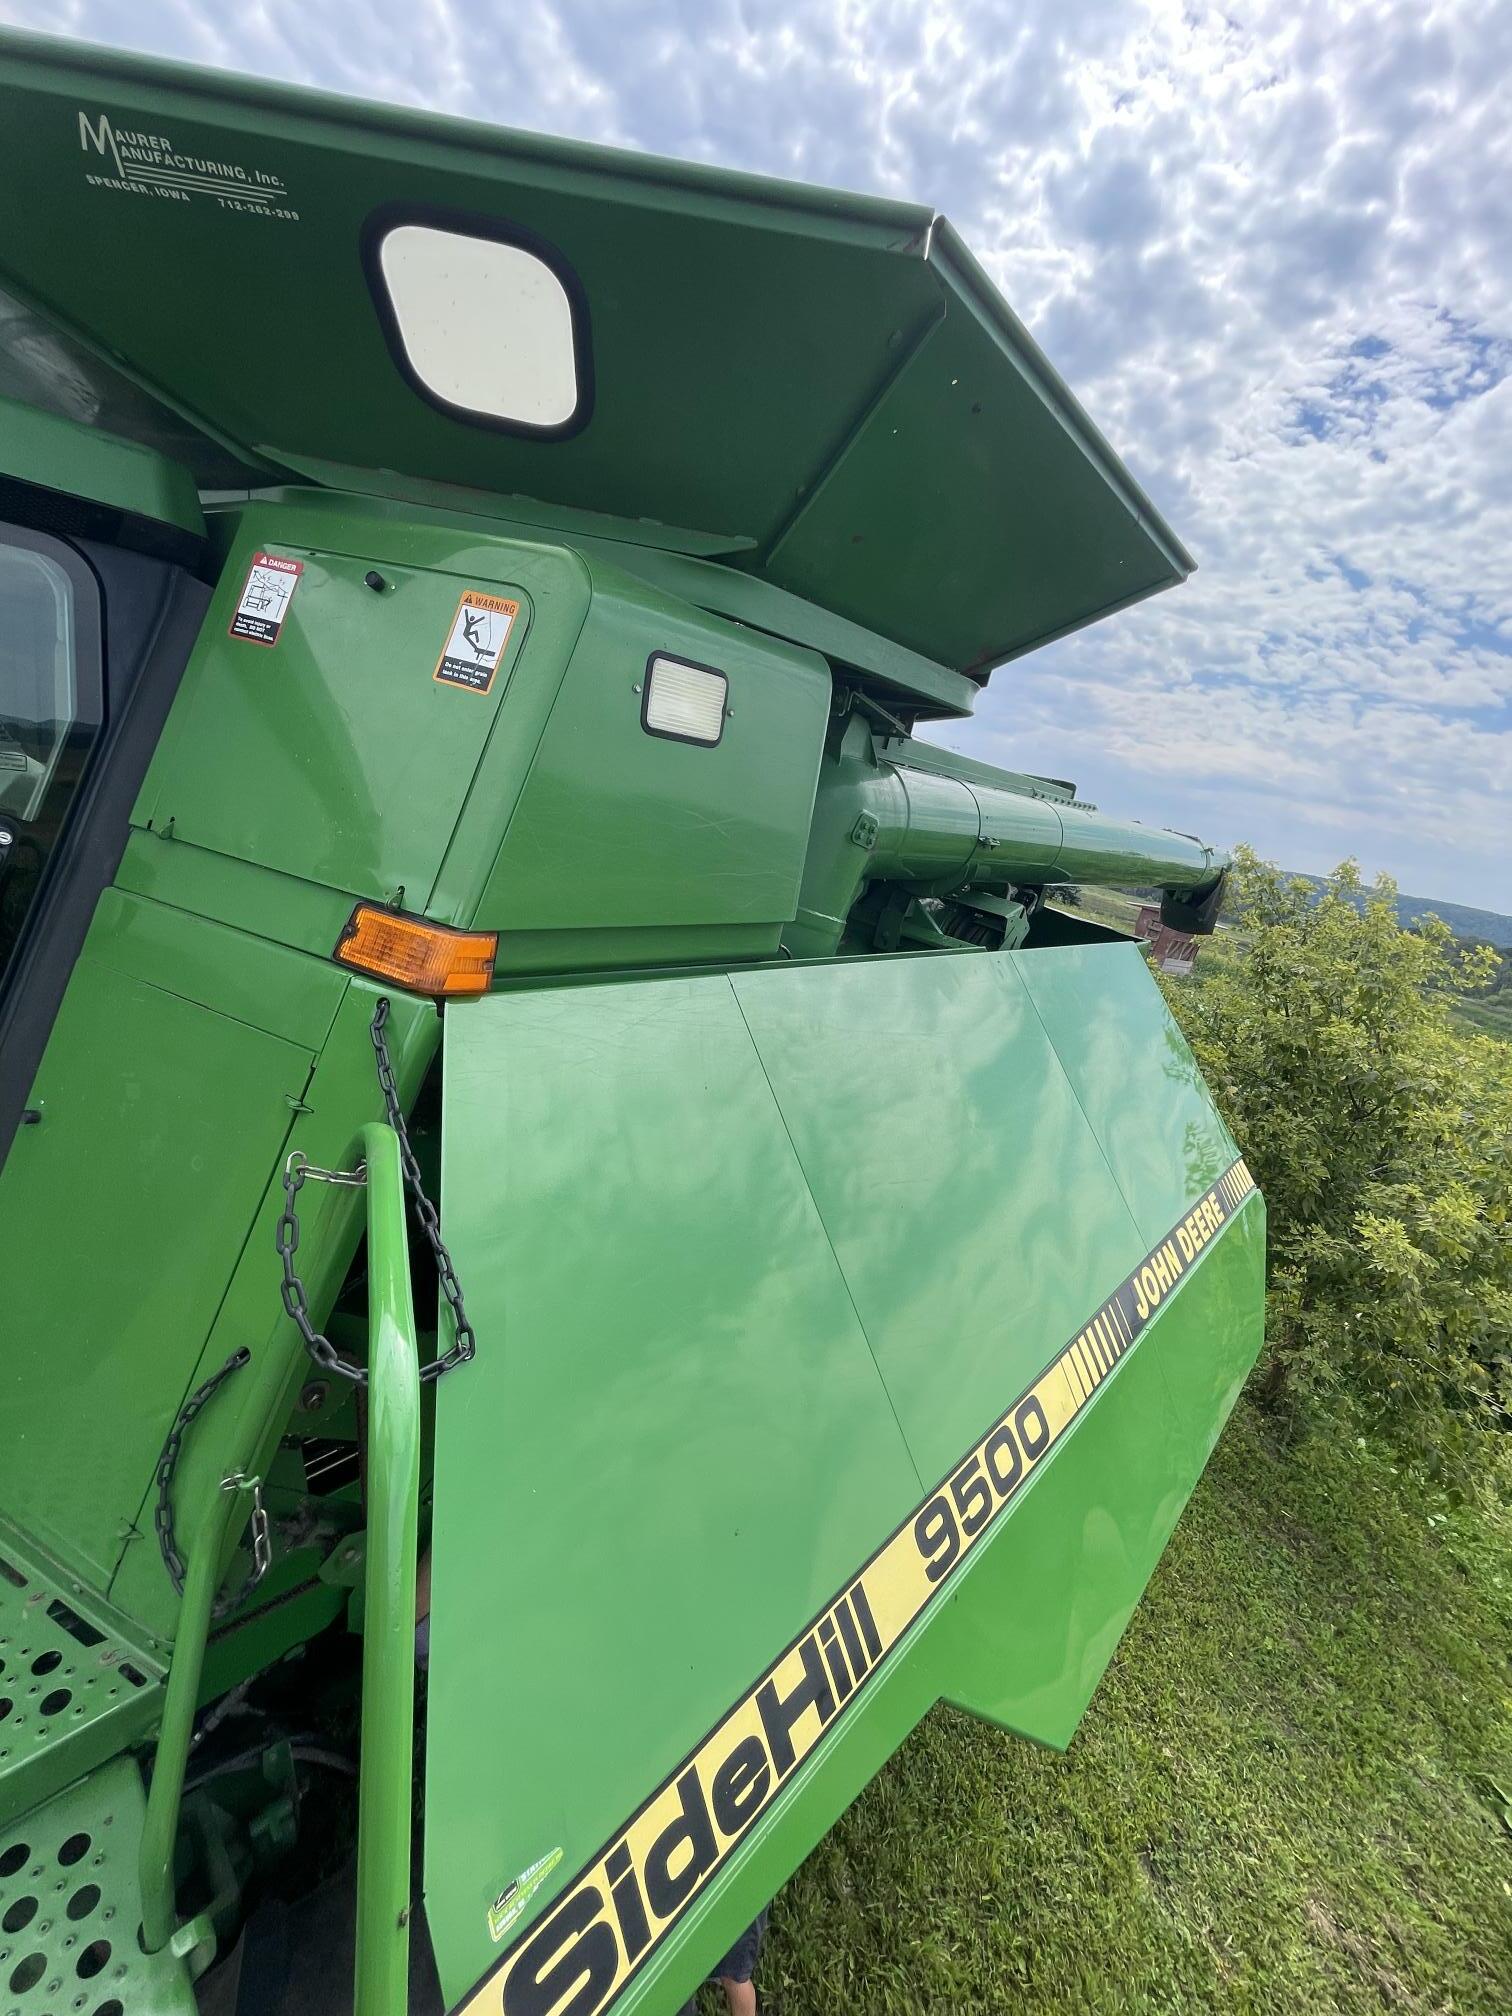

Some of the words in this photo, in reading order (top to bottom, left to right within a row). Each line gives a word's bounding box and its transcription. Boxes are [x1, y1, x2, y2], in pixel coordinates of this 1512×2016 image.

[85, 174, 154, 196] SPENCER,
[154, 185, 191, 202] IOWA
[268, 558, 297, 572] DANGER
[475, 596, 516, 614] WARNING
[1132, 1239, 1184, 1320] JOHN
[1176, 1191, 1226, 1264] DEERE
[502, 1580, 884, 2016] SideHill
[913, 1396, 1052, 1584] 9500
